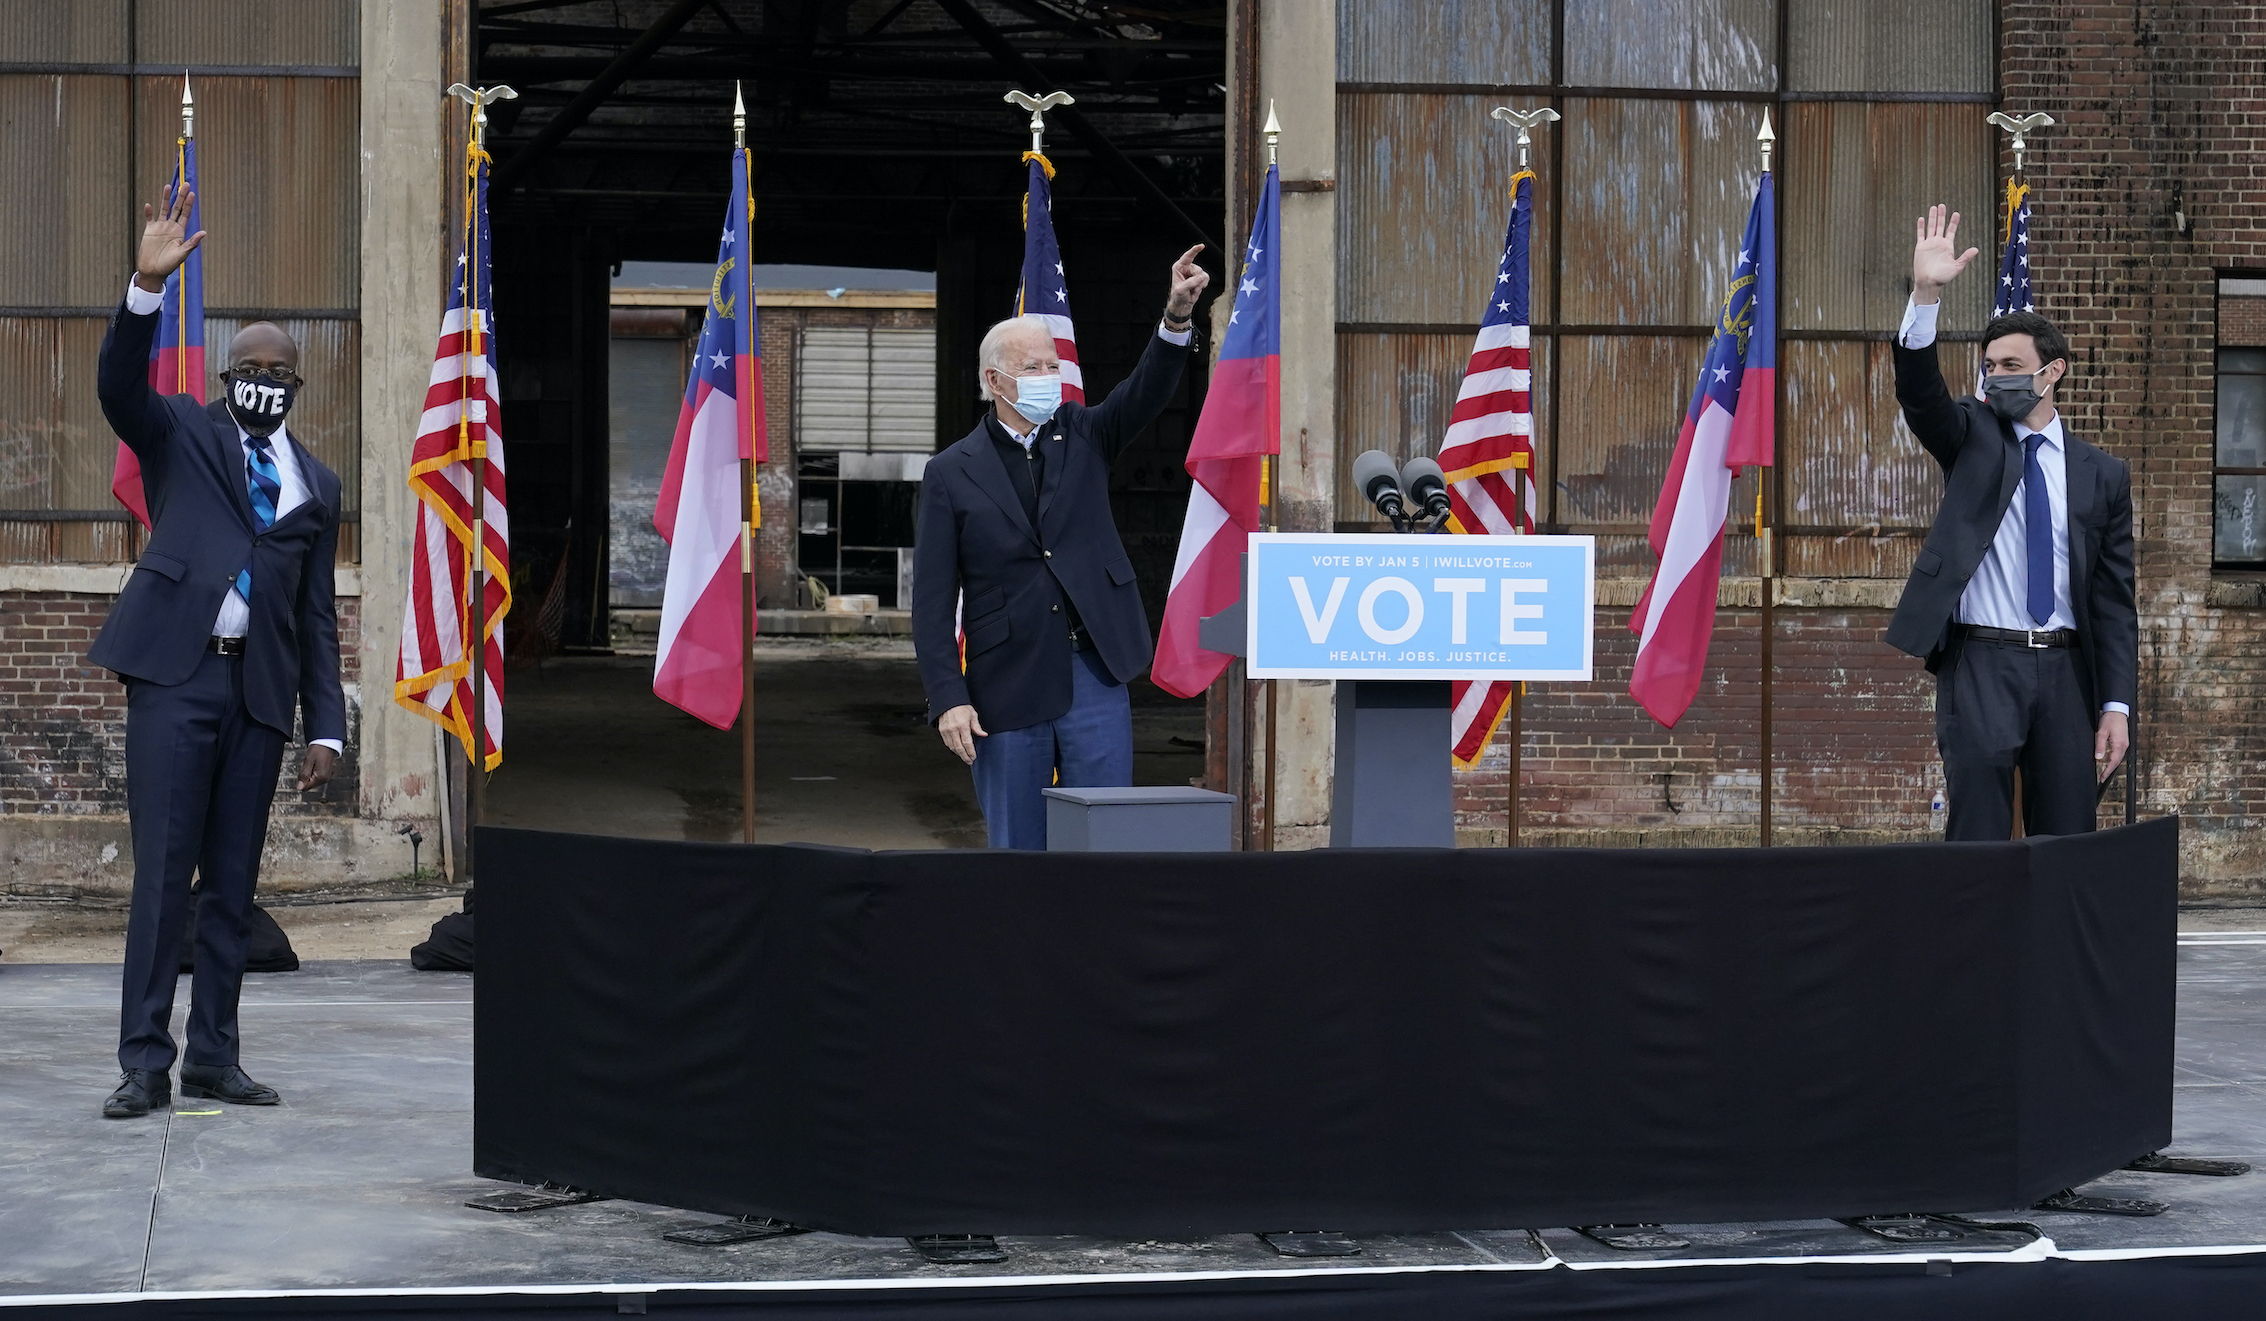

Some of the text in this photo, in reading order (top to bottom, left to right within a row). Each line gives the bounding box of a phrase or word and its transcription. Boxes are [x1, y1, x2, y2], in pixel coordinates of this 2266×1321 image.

[234, 380, 285, 416] VOTE
[1312, 556, 1533, 569] VOTE BY JAN 5 IWILLVOTE.COM
[1288, 576, 1548, 645] VOTE
[1329, 651, 1511, 663] HEALTH. JOBS. JUSTICE.
